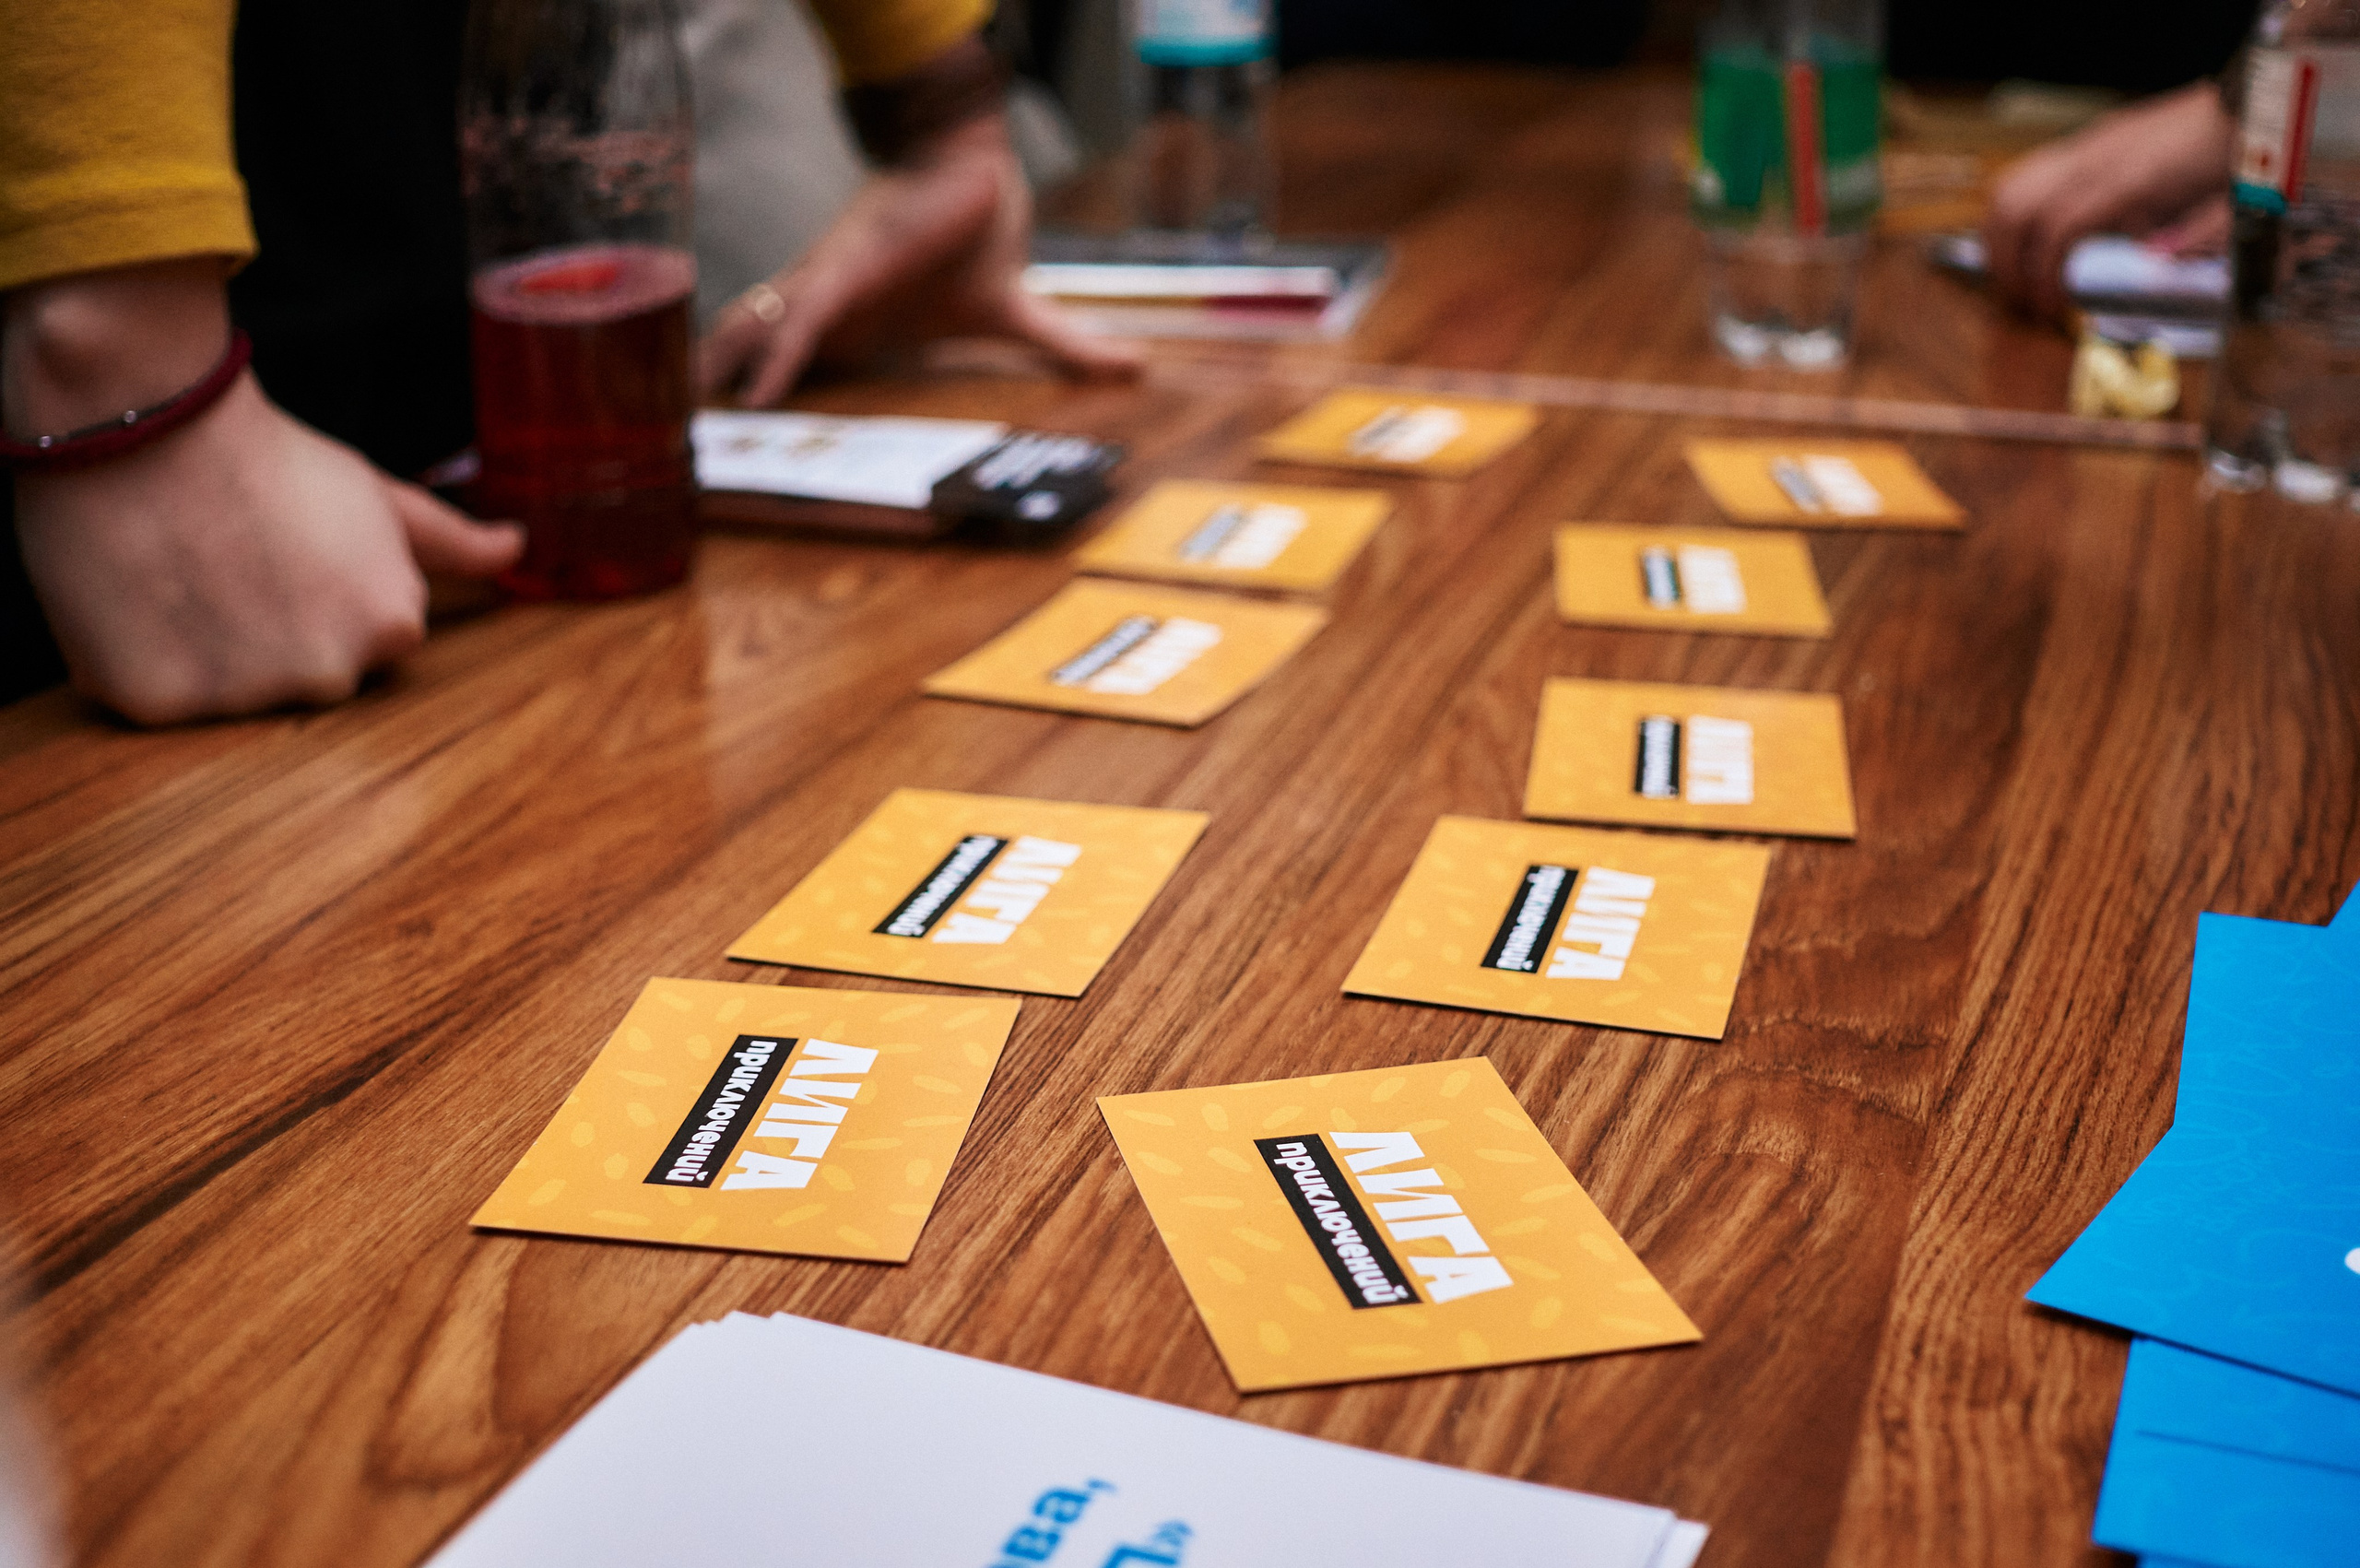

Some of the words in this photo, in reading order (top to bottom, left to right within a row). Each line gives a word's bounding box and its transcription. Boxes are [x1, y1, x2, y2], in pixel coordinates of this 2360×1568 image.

[931, 835, 1081, 944] ЛИГА
[1545, 866, 1655, 980] ЛИГА
[665, 1040, 777, 1182] приключений
[720, 1038, 879, 1190] ЛИГА
[1274, 1141, 1409, 1304] приключений
[1328, 1131, 1514, 1303] ЛИГА
